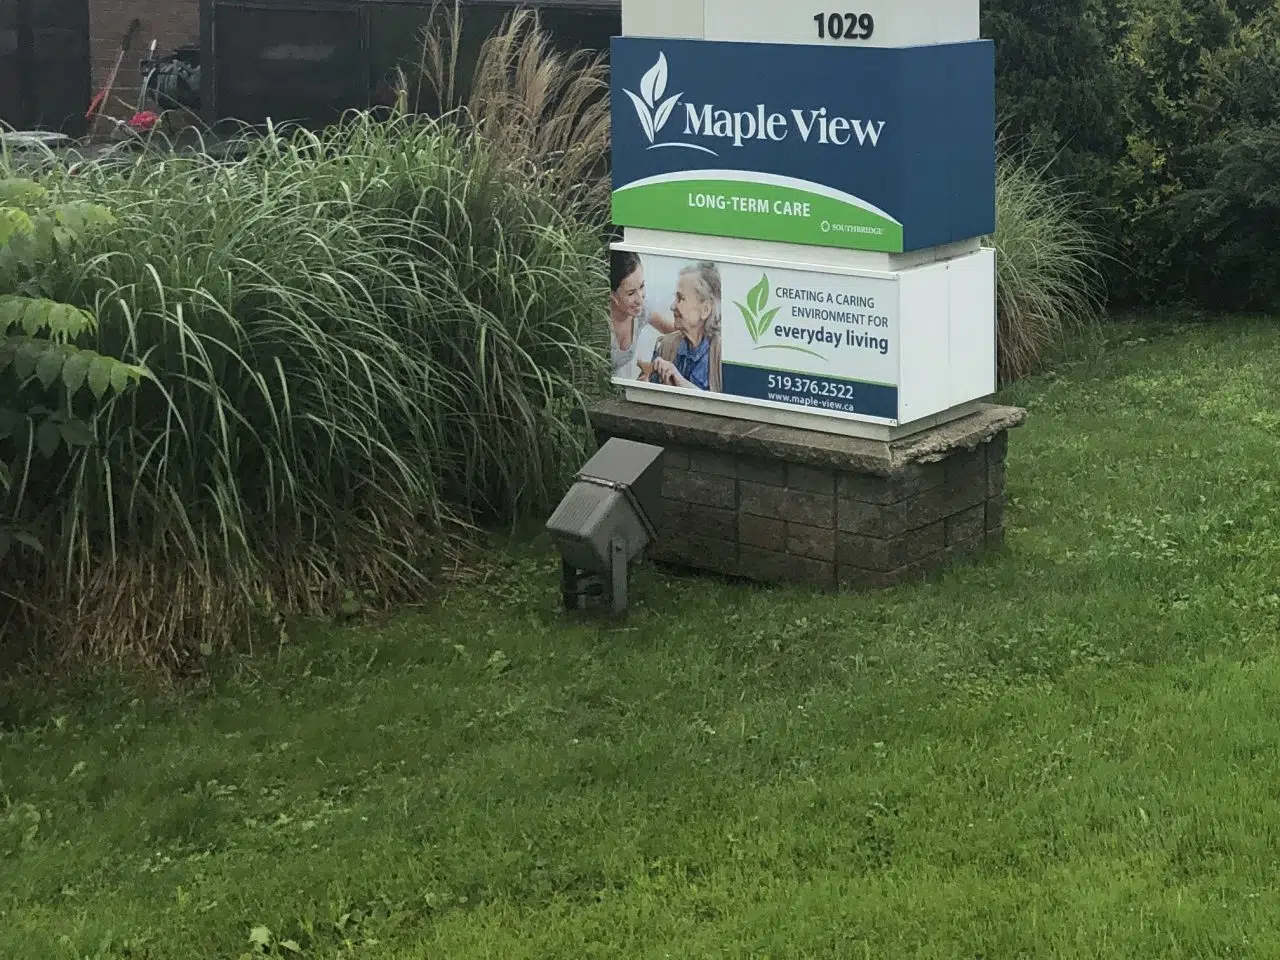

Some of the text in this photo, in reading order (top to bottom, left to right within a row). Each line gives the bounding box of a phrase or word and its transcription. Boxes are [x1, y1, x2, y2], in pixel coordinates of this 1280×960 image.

[813, 12, 875, 40] 1029
[683, 102, 886, 147] Maple View
[688, 192, 811, 217] LONG-TERM CARE
[831, 223, 884, 236] SOUTHBRIDGE
[775, 286, 875, 309] CREATING A CARING
[791, 306, 889, 328] ENVIRONMENT FOR
[774, 324, 889, 354] everyday living
[768, 374, 854, 400] 519.376.2522
[768, 392, 854, 412] www.maple-view.ca
